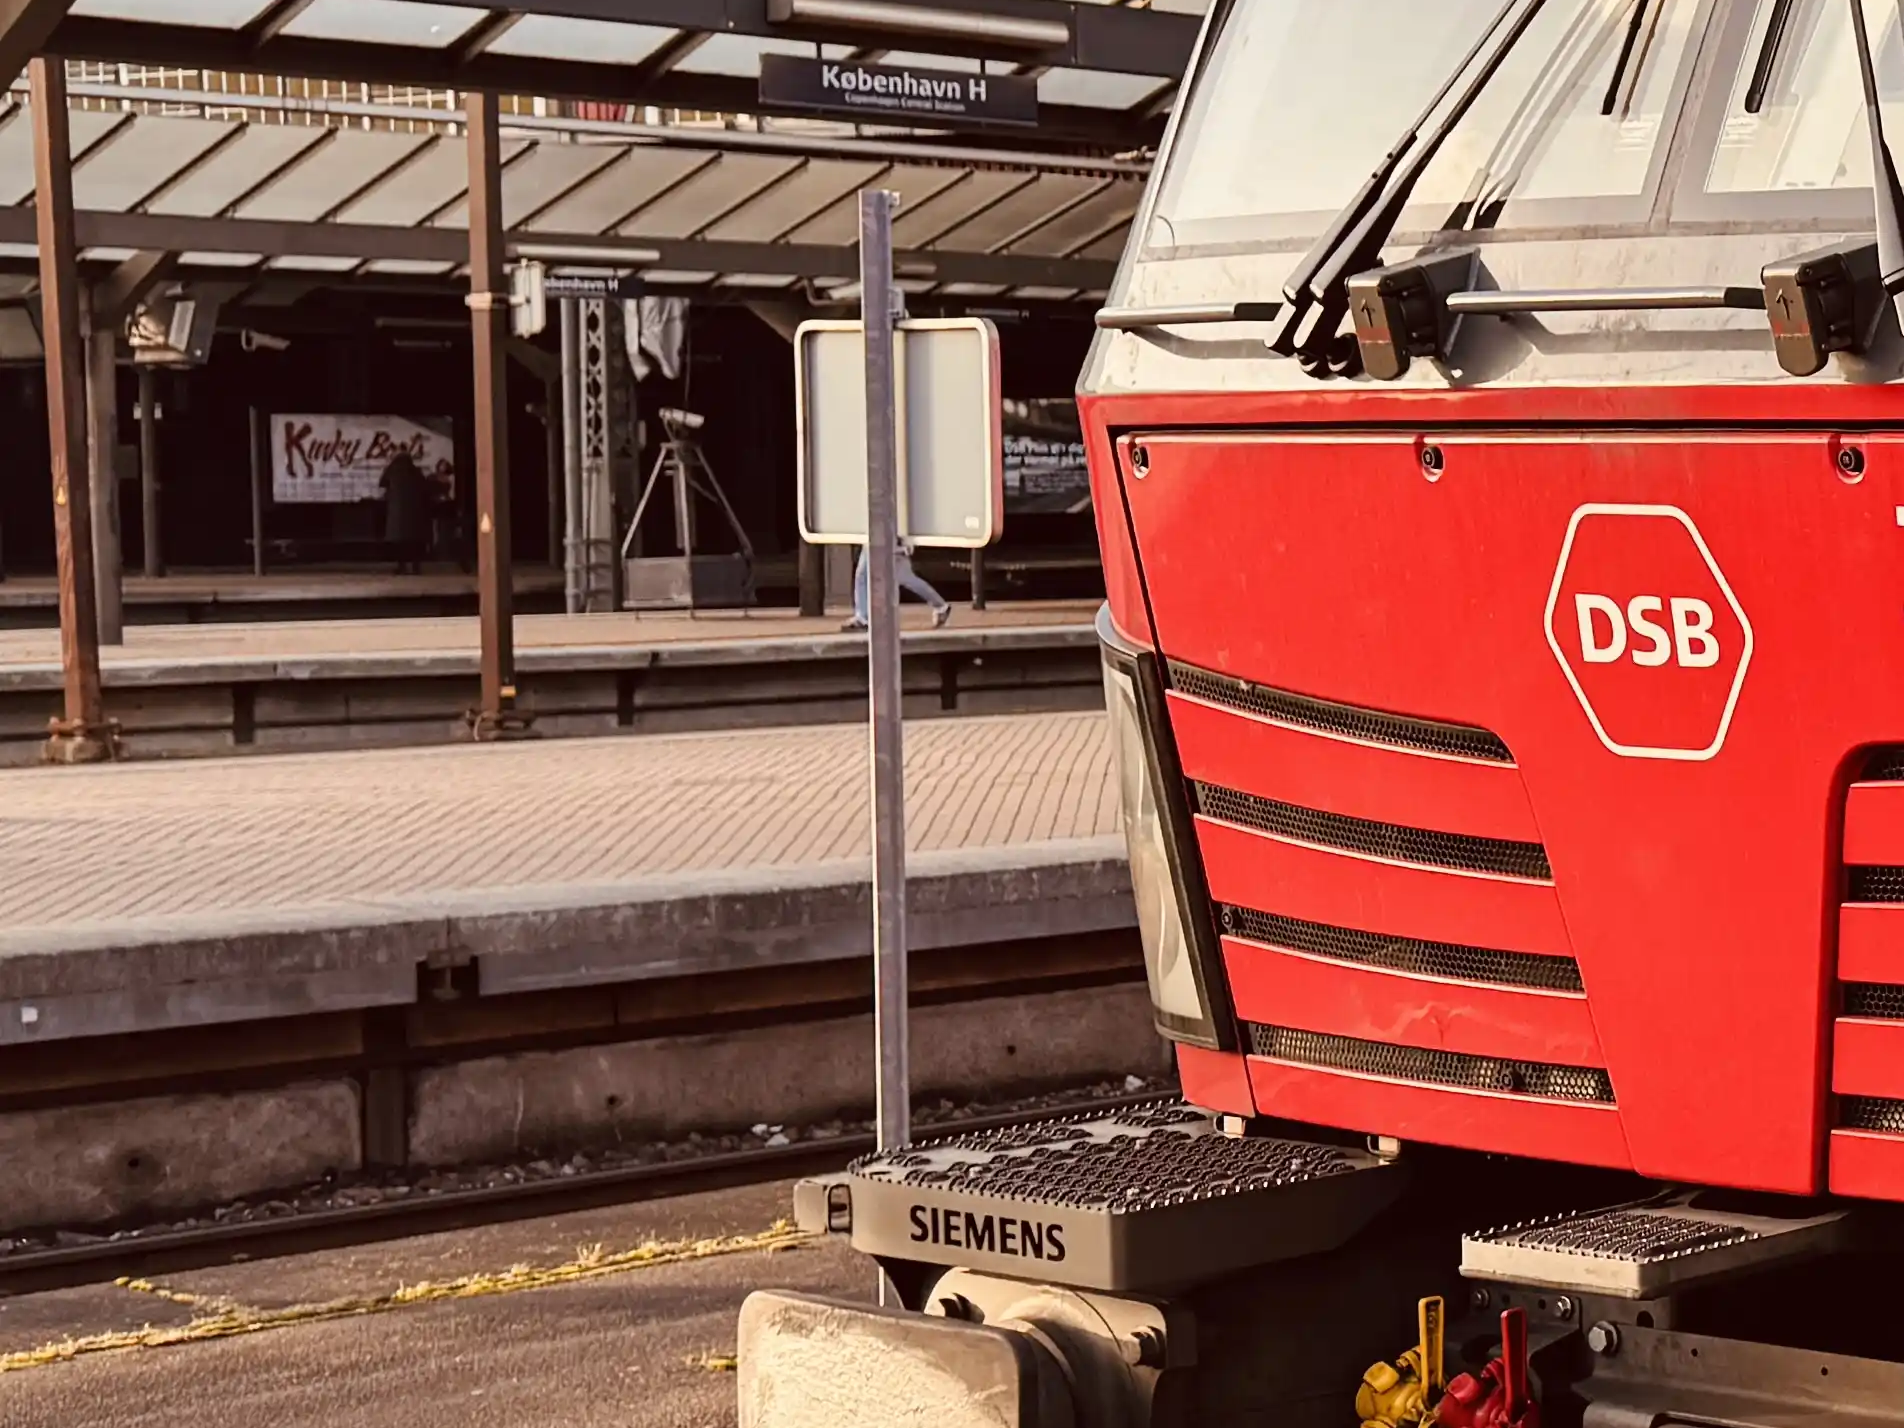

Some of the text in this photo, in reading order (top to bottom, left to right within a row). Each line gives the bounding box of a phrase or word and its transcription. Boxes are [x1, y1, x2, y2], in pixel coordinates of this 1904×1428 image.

[822, 64, 987, 102] København H
[284, 421, 362, 478] Kinky
[1574, 592, 1721, 669] DSB
[910, 1204, 1066, 1262] SIEMENS
